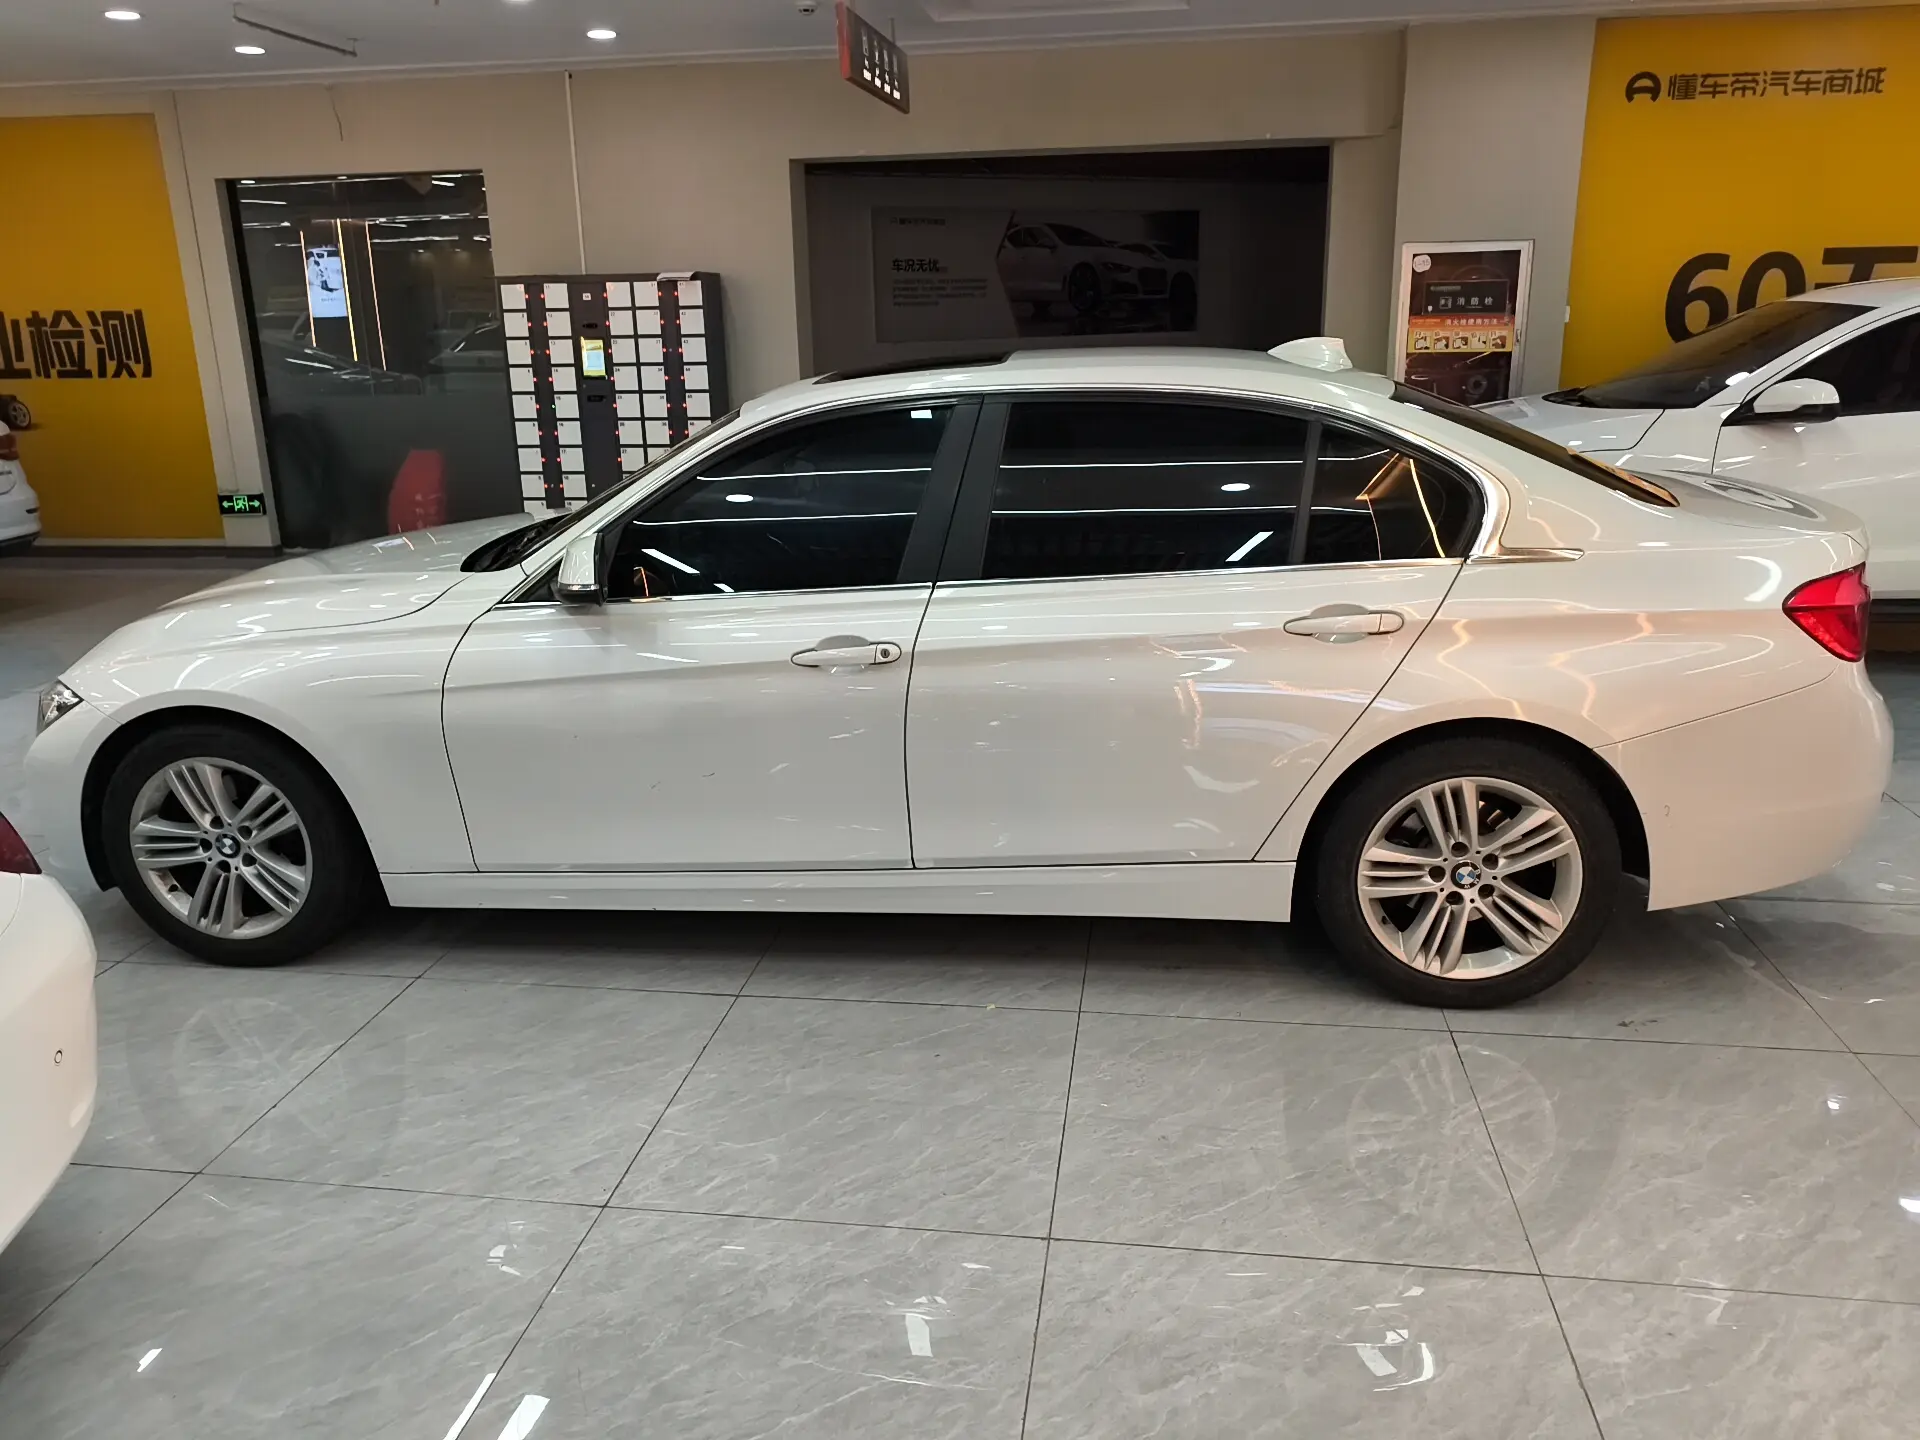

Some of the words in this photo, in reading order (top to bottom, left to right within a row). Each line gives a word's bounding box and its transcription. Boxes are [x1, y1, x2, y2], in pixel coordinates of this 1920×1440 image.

[1667, 66, 1887, 101] 懂车帝汽车商城
[891, 257, 941, 273] 车况无忧
